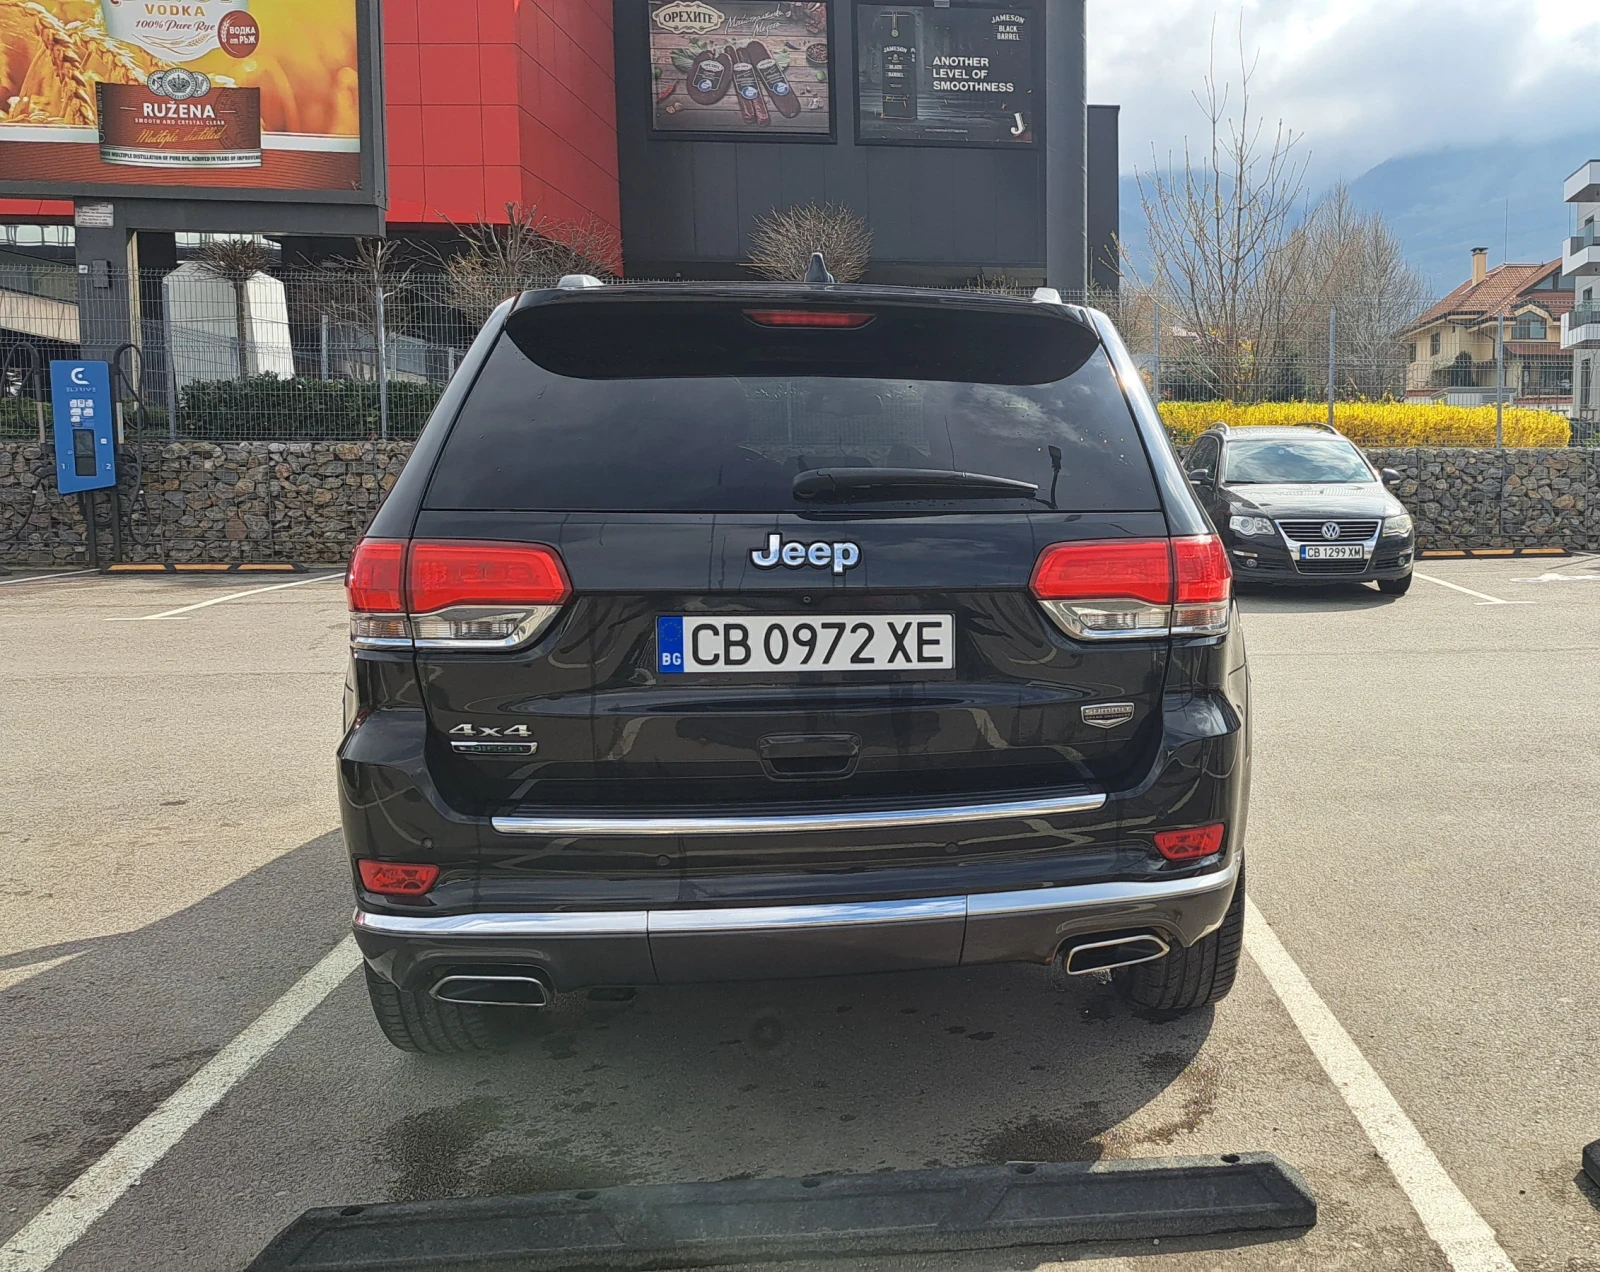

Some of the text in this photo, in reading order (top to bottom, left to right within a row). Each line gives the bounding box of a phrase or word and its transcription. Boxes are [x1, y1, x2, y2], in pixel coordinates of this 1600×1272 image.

[145, 4, 206, 17] VODKA
[663, 11, 715, 24] ОРЕХИТЕ
[991, 14, 1025, 24] JAMESON
[135, 20, 216, 32] 100% Pure Rye
[229, 26, 256, 36] ВОДКА
[998, 25, 1018, 33] BLACK
[239, 35, 256, 44] РЪЖ
[996, 32, 1020, 41] BARREL
[932, 56, 989, 67] ANOTHER
[932, 69, 988, 79] LEVEL OF
[933, 81, 1014, 92] SMOOTHNESS
[143, 101, 216, 119] RUŽENA
[1010, 112, 1025, 135] J
[751, 533, 860, 573] Jeep
[1307, 547, 1361, 558] CB 1299 XM
[691, 621, 943, 666] CB 0972 XE
[661, 652, 682, 666] BG
[448, 723, 533, 737] 4x4
